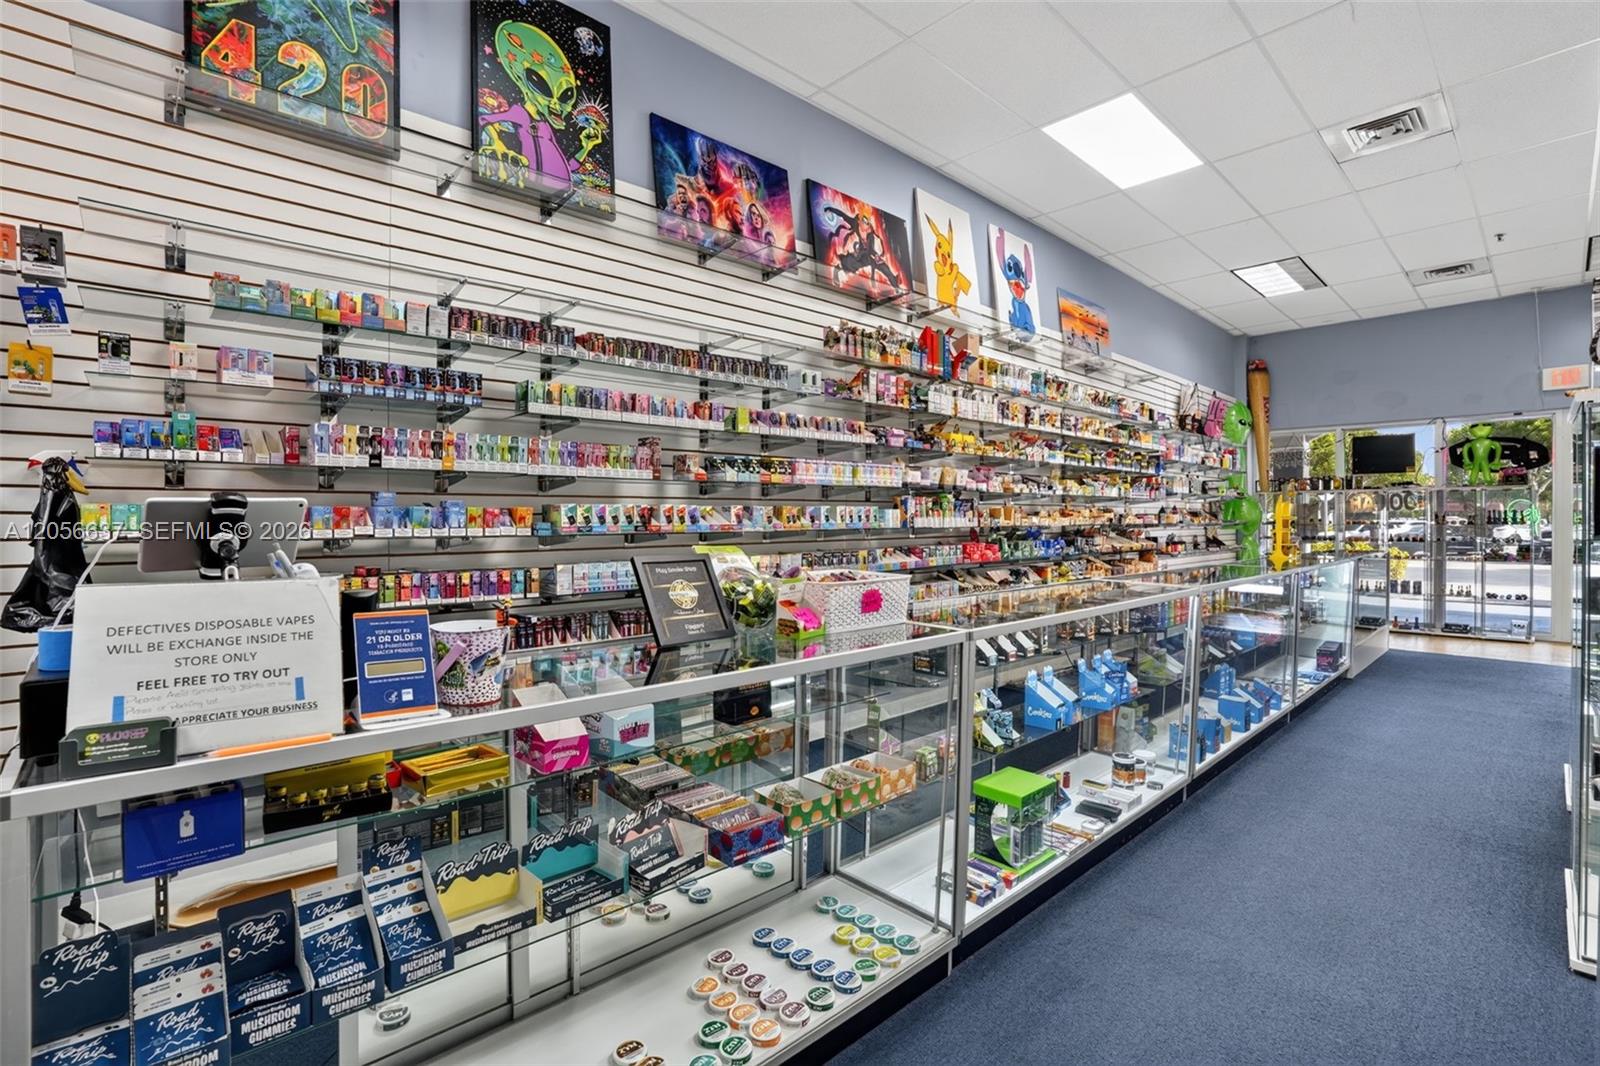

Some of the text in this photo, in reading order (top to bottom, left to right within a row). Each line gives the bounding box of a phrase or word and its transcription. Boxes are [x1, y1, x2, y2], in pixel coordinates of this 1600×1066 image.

[200, 18, 389, 140] 420
[106, 615, 316, 637] DEFECTIVES DISPOSABLE VAPES
[106, 631, 314, 655] WILL BE EXCHANGE INSIDE THE
[366, 632, 423, 644] 21 OR OLDER
[174, 652, 258, 667] STORE ONLY
[137, 668, 291, 691] FEEL FREE TO TRY OUT
[241, 707, 270, 719] YOUR
[272, 701, 319, 715] BUSINESS
[616, 799, 663, 838] Road Trip
[529, 816, 593, 854] Road Trip
[376, 837, 408, 858] Road
[387, 850, 411, 866] Trip
[630, 843, 650, 860] Road
[437, 843, 512, 885] Road Trip
[312, 898, 344, 920] Road
[237, 915, 277, 940] Road
[252, 927, 280, 946] Trip
[316, 925, 348, 948] Road
[387, 918, 415, 938] Road
[401, 928, 422, 942] Trip
[52, 935, 105, 966] Road
[330, 936, 354, 952] Trip
[72, 950, 110, 974] Trip
[322, 979, 375, 1006] MUSHROOM
[328, 992, 372, 1016] GUMMIES
[156, 1002, 200, 1032] Road
[173, 1016, 205, 1036] Trip
[241, 1003, 301, 1035] MUSHROOM
[248, 1018, 297, 1045] GUMMIES
